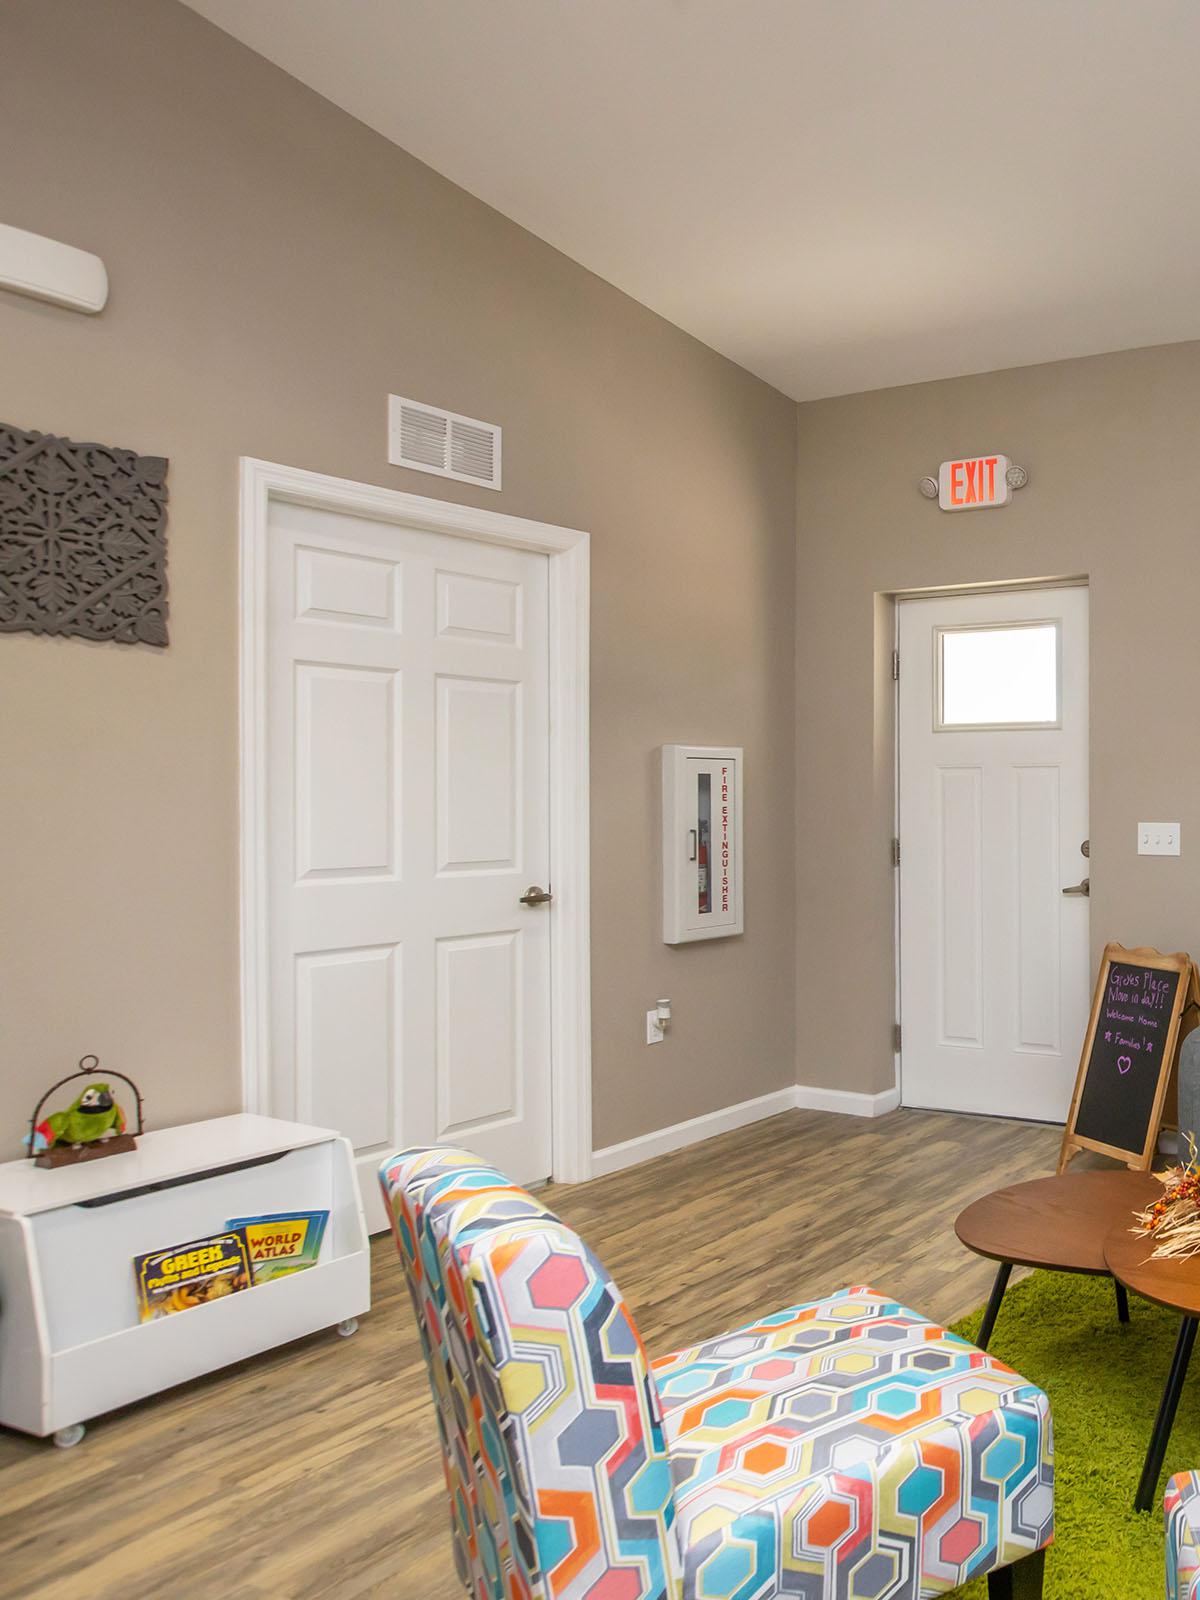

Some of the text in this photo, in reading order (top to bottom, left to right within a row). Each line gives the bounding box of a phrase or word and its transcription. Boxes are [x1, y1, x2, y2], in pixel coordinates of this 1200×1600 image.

[950, 458, 997, 505] EXIT
[1143, 971, 1169, 993] Place
[1106, 1008, 1158, 1029] Welcome Home
[251, 1233, 302, 1248] WORLD
[161, 1244, 224, 1275] GREEK
[254, 1244, 295, 1260] ATLAS
[180, 1267, 200, 1280] and
[200, 1256, 242, 1275] Legends
